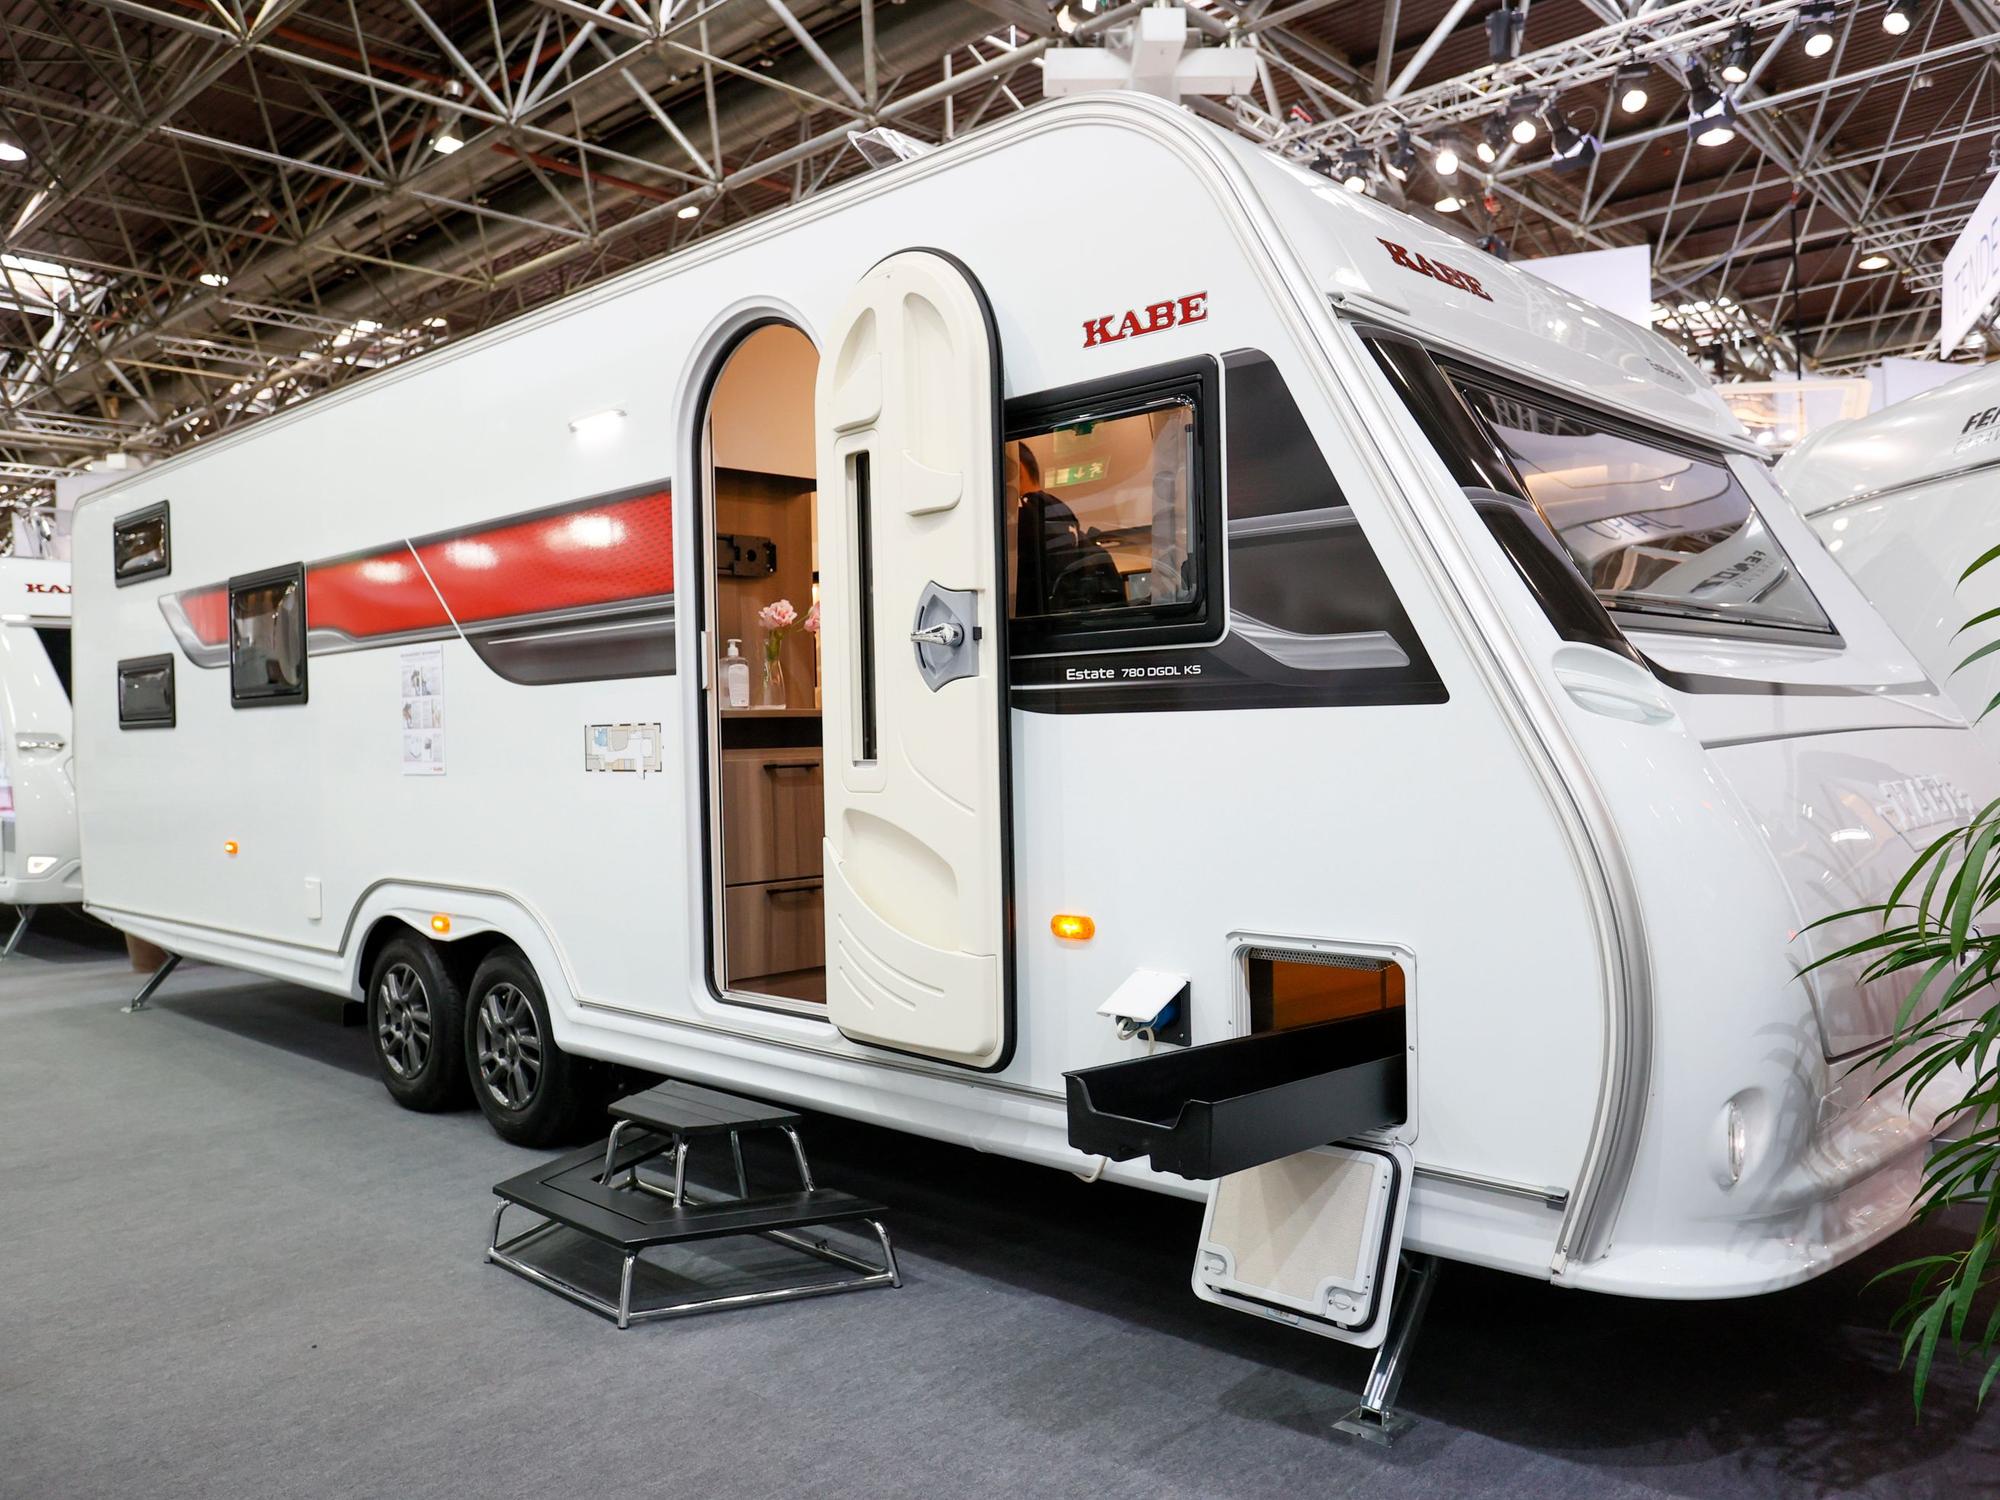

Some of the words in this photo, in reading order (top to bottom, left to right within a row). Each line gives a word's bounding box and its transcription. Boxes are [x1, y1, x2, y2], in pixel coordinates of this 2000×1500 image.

[1376, 236, 1494, 302] KABE
[1082, 290, 1208, 350] KABE
[1066, 667, 1115, 680] Estate
[1121, 667, 1145, 678] 780
[1147, 665, 1181, 677] DGDL
[1184, 664, 1202, 675] KS
